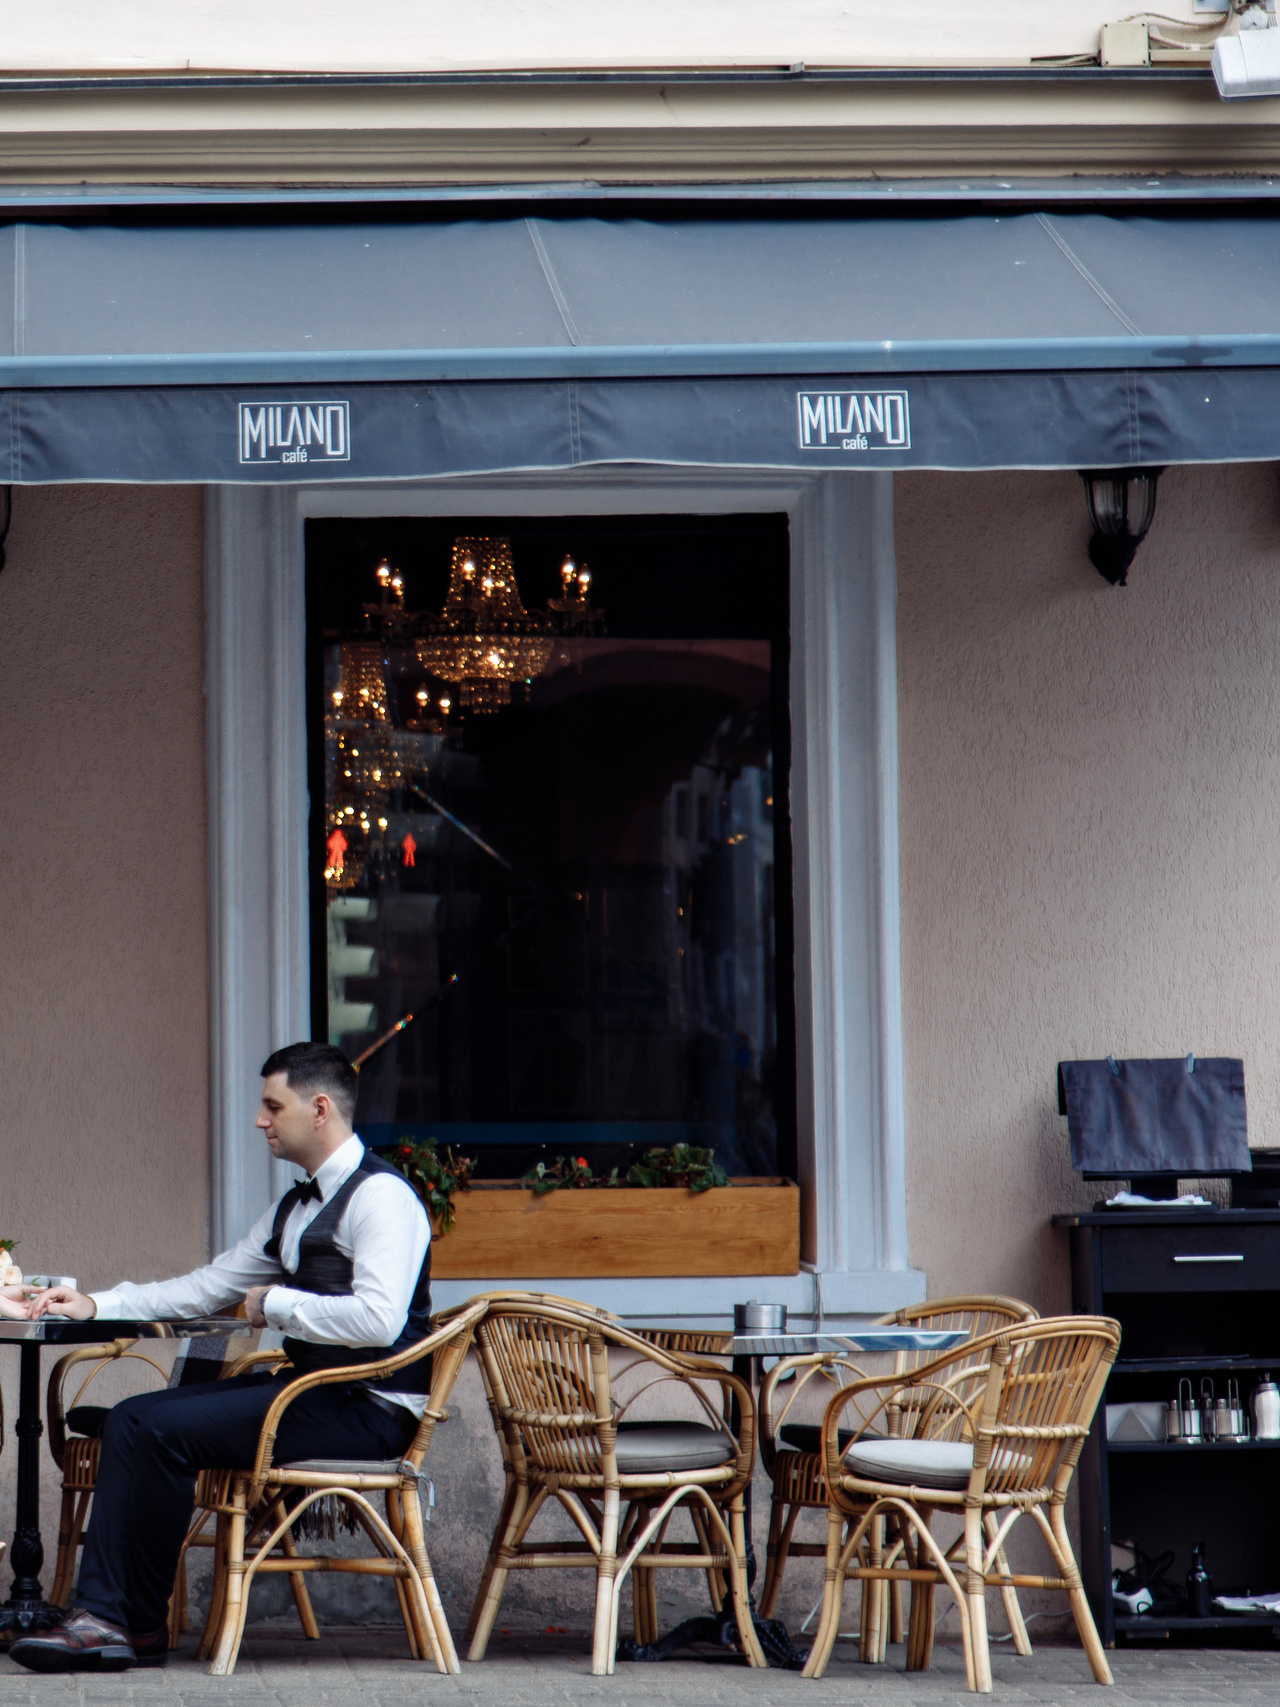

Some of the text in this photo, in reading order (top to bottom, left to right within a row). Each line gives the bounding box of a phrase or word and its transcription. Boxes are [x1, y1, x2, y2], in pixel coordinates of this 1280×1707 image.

[245, 405, 345, 458] MILANO
[803, 395, 903, 444] MILANO
[282, 446, 307, 463] café
[842, 434, 868, 450] café
